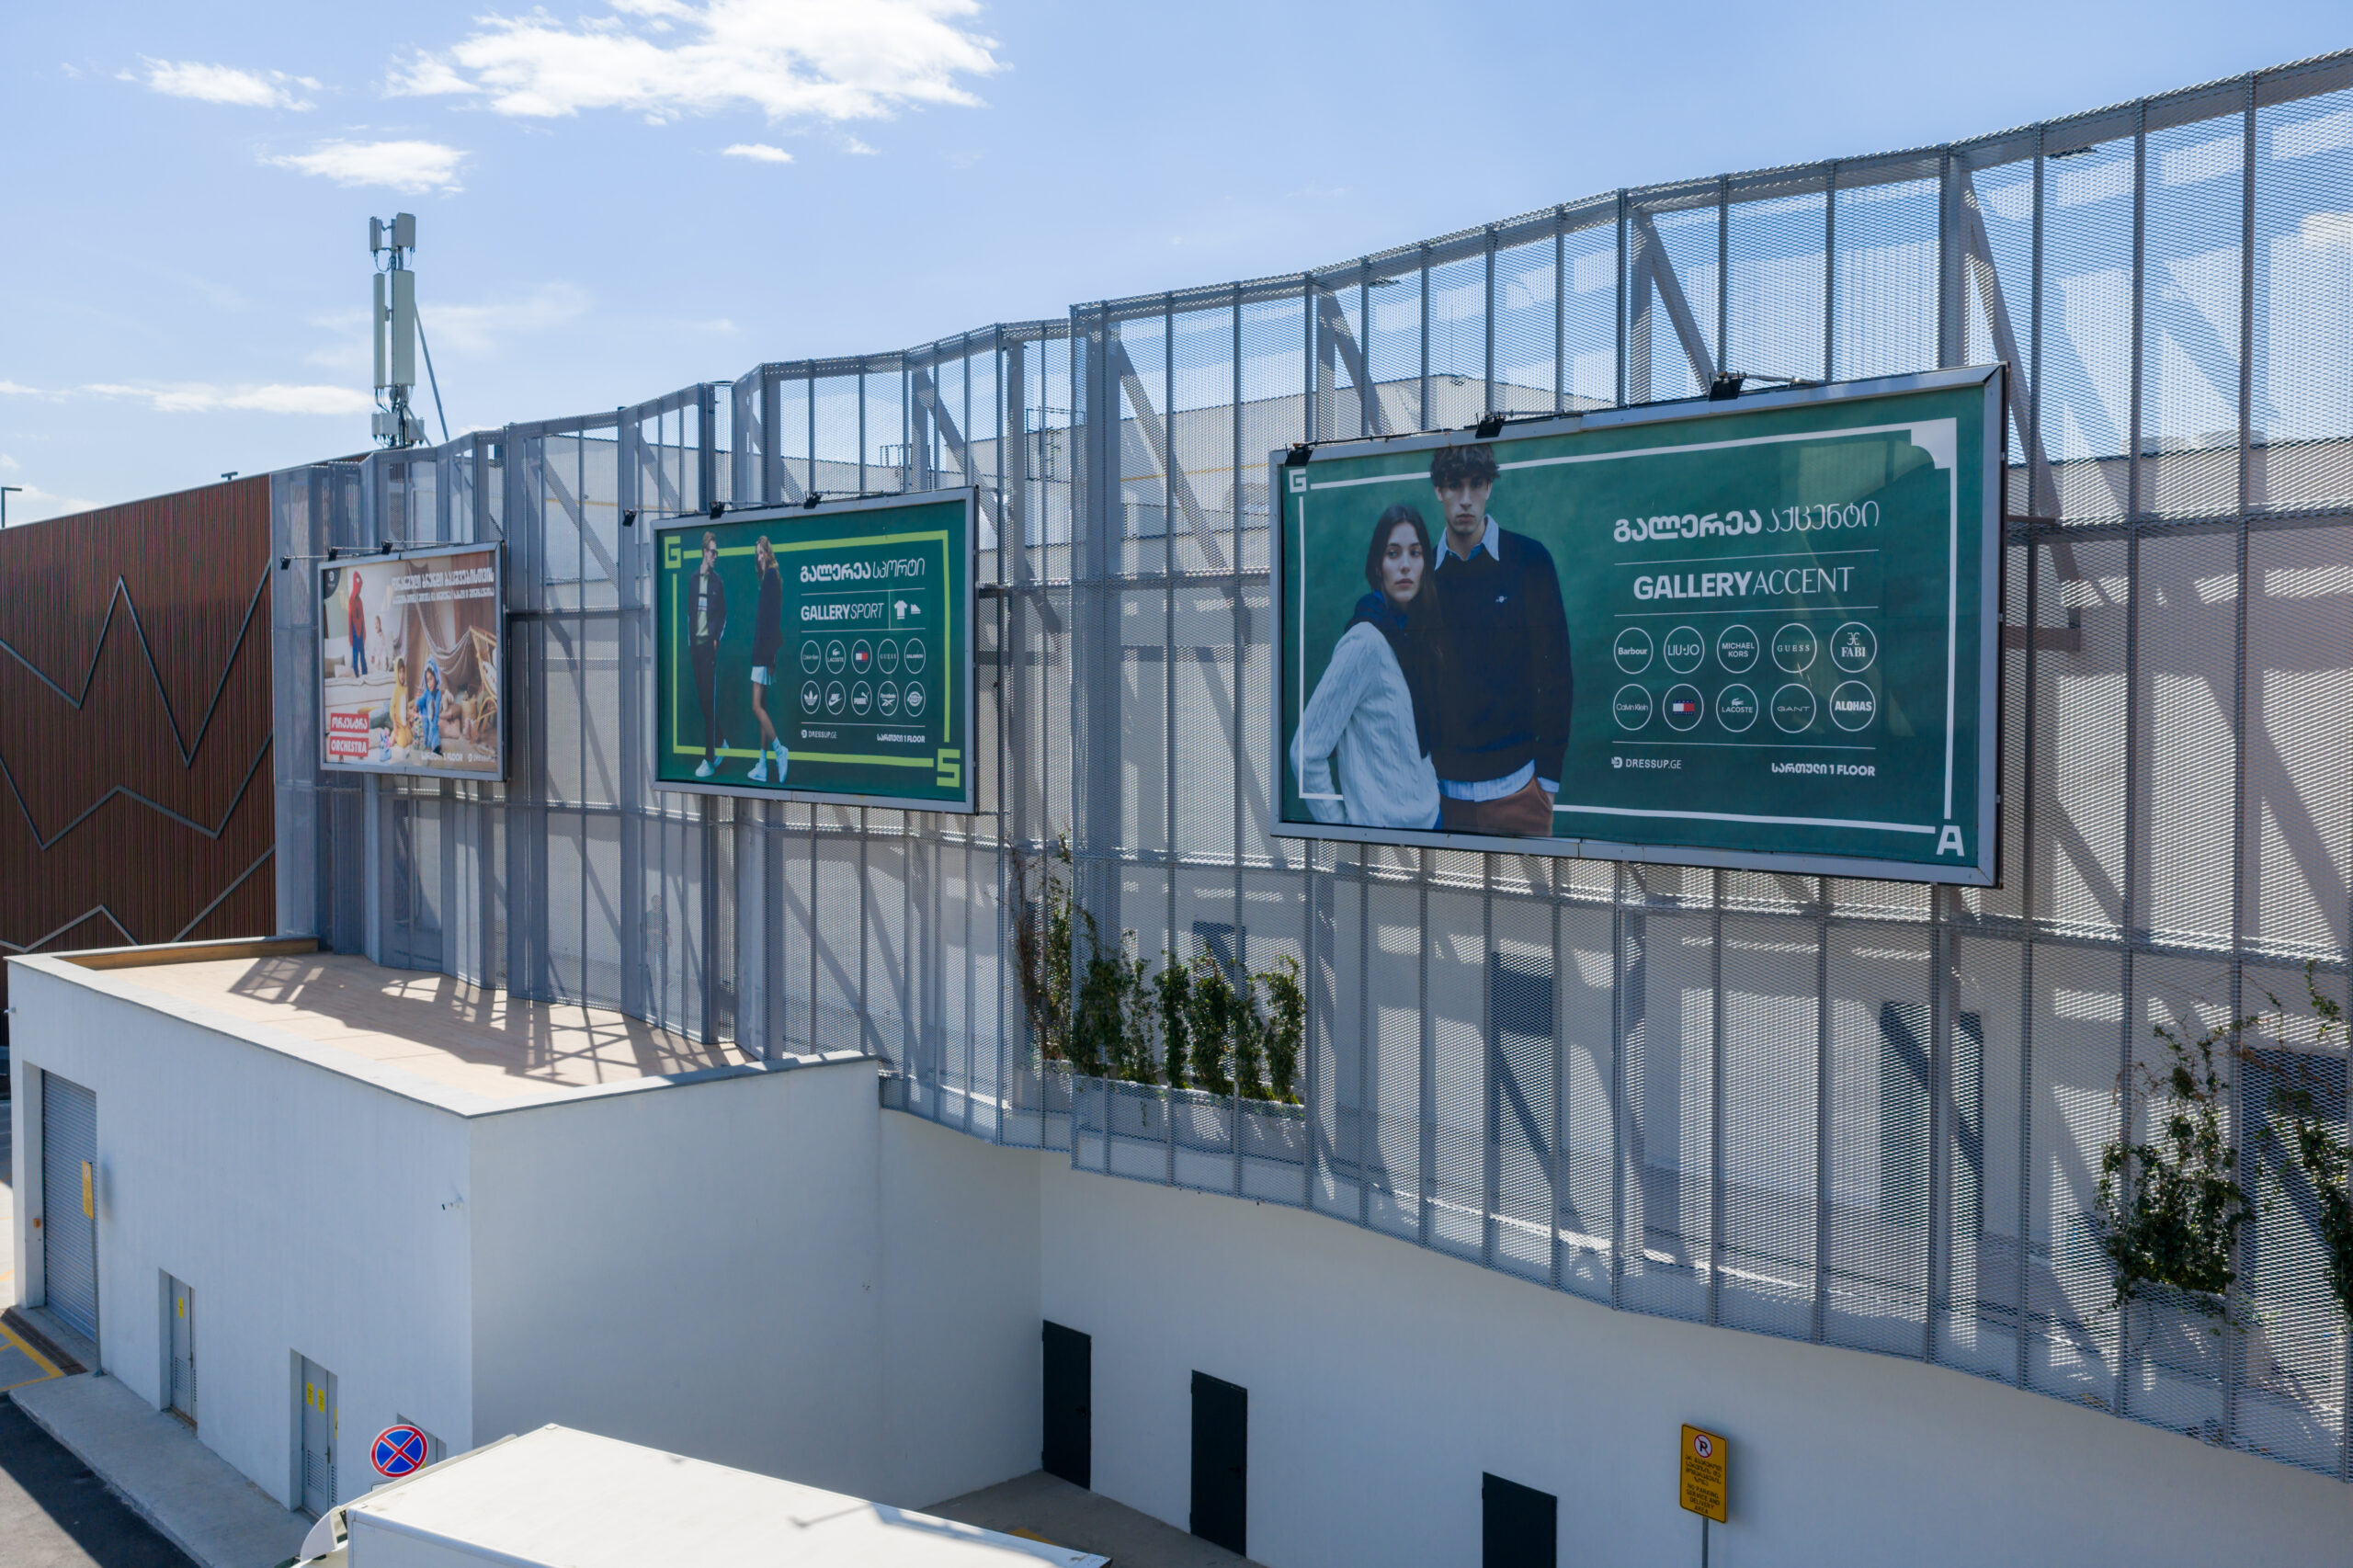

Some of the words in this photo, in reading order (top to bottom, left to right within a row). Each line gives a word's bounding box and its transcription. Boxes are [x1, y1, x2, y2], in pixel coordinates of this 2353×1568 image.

[1618, 646, 1648, 655] Barbour
[1722, 642, 1755, 651] MICHAEL
[1777, 643, 1811, 653] GUESS
[1841, 646, 1866, 658] FABI
[1728, 650, 1749, 658] KORS
[1835, 700, 1872, 712] ALOHAS
[331, 740, 367, 754] ORCHESTRA
[1625, 758, 1682, 770] DRESSUP.GE
[1829, 764, 1836, 775] 1
[1836, 765, 1876, 777] FLOOR
